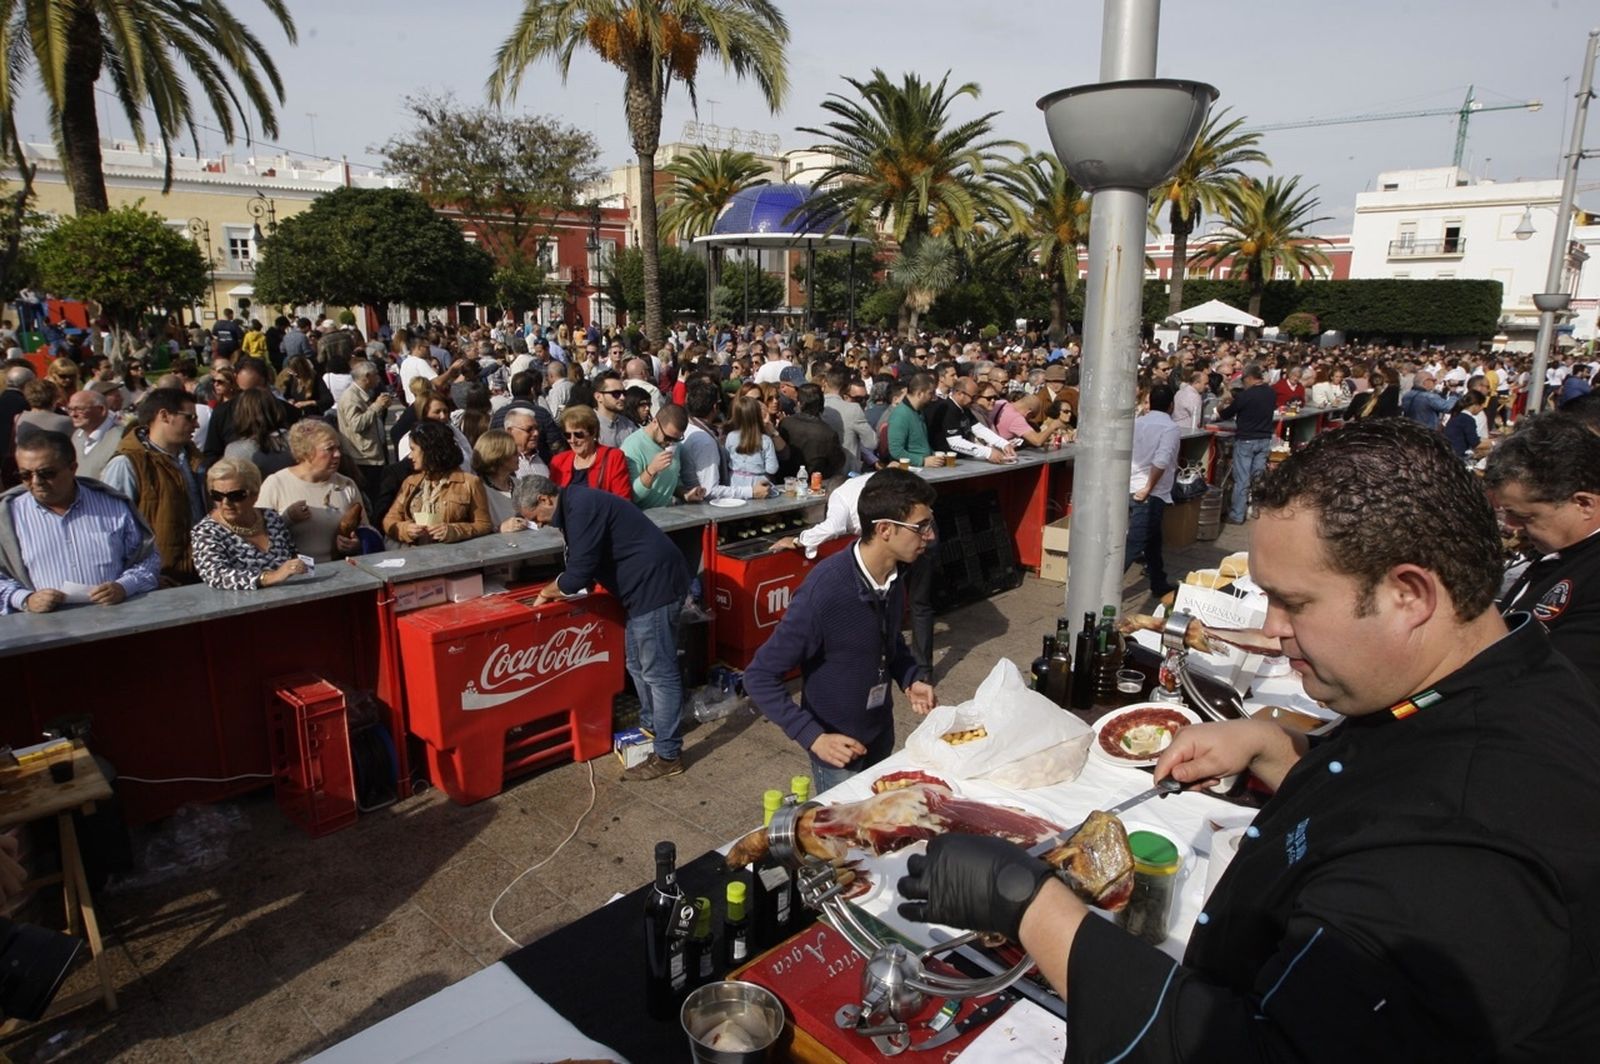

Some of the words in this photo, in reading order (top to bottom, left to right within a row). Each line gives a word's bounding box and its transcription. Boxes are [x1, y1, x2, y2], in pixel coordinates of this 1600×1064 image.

[1201, 601, 1246, 625] FERNANDO
[480, 621, 599, 690] Coca-Cola
[826, 949, 861, 978] vier
